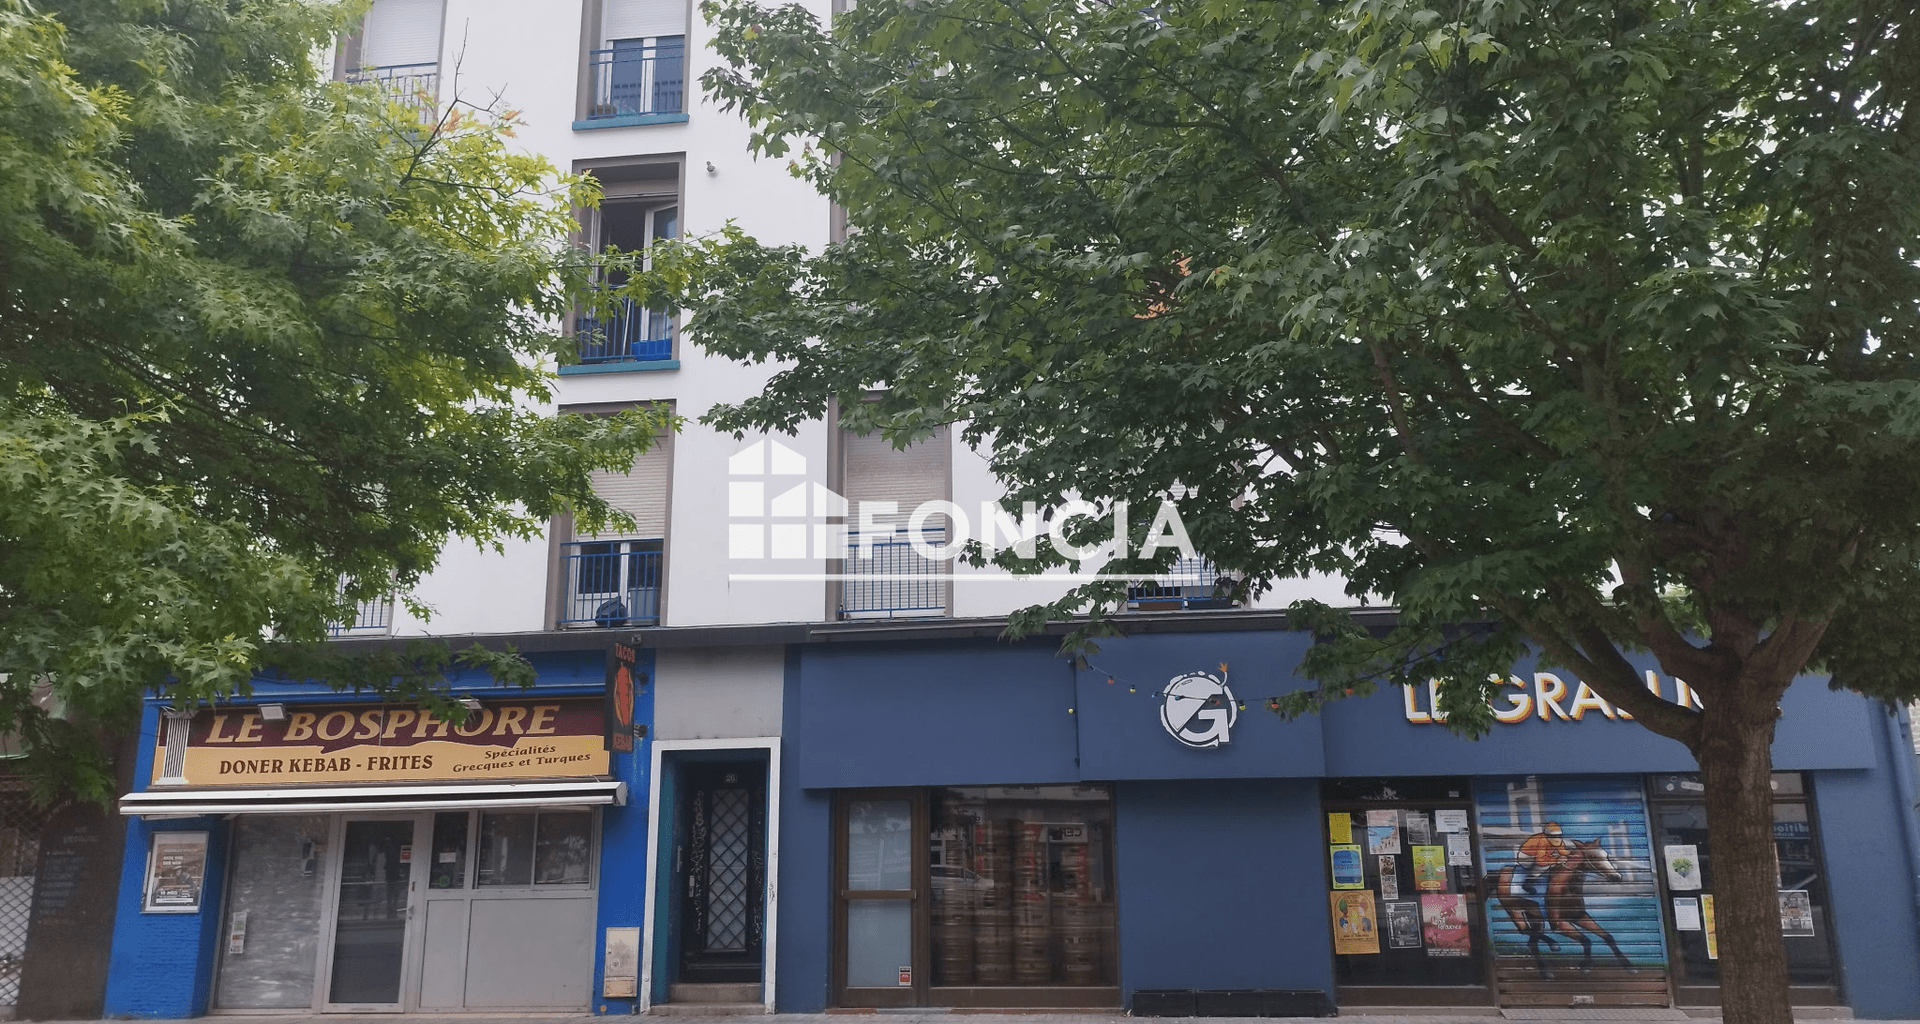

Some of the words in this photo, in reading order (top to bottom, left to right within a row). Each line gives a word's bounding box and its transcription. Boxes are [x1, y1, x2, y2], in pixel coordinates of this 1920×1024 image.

[614, 642, 636, 663] TACOS
[205, 714, 264, 743] LE
[283, 705, 560, 741] BOSPHORE
[485, 745, 556, 760] Spécialités
[219, 759, 284, 774] DONER
[288, 757, 351, 773] KEBAB
[367, 755, 433, 771] FRITES
[453, 760, 514, 773] Grecques
[519, 758, 531, 766] et
[536, 753, 591, 765] Turques
